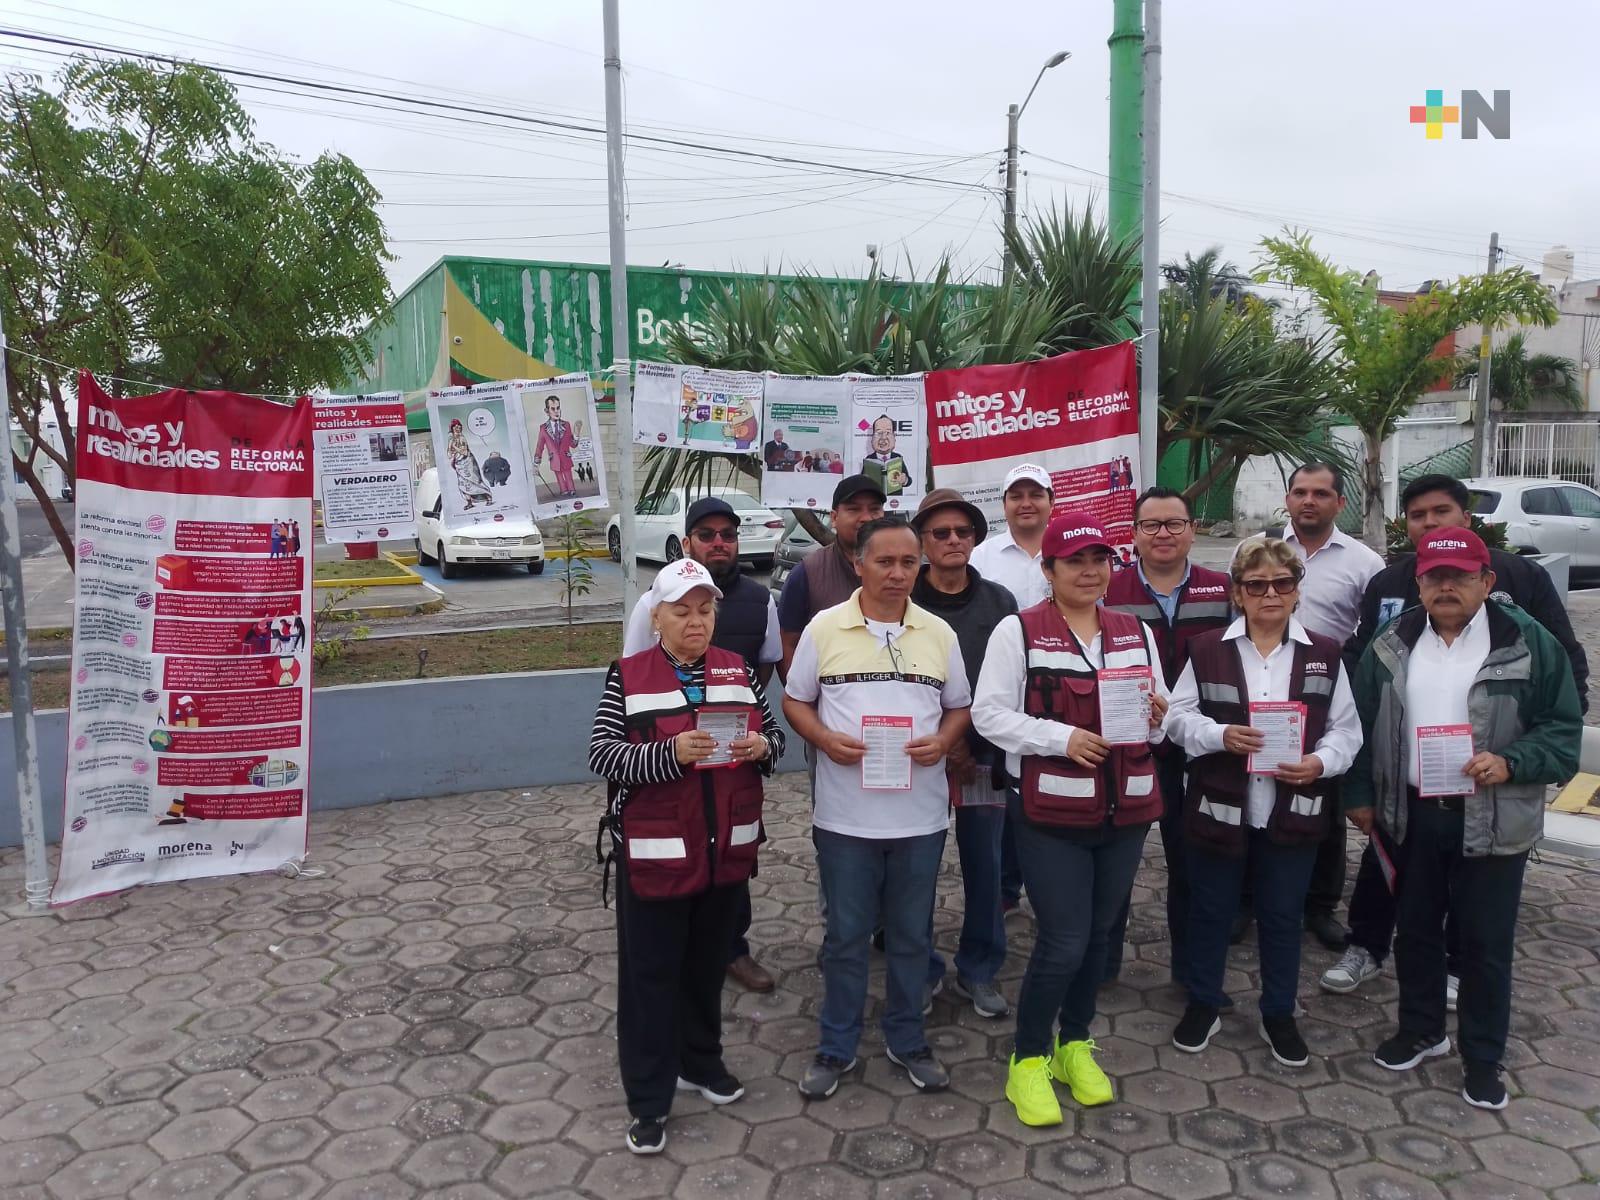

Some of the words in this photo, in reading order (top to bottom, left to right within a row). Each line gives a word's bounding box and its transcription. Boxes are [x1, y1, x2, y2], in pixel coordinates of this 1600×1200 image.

[440, 387, 469, 398] Formación
[476, 384, 509, 394] Movimiento
[1067, 389, 1085, 400] DE
[326, 396, 357, 404] Formación
[936, 391, 1004, 418] mitos
[1009, 388, 1026, 413] y
[1067, 390, 1130, 412] REFORMA
[315, 409, 346, 418] mitos
[351, 409, 358, 418] y
[1068, 401, 1131, 423] ELECTORAL
[87, 404, 161, 443] mos
[164, 420, 184, 447] y
[316, 418, 372, 428] realidades
[938, 407, 1061, 443] realidades
[231, 437, 251, 447] DE
[327, 433, 356, 443] FALSO
[87, 433, 220, 470] realidades
[230, 448, 305, 461] REFORMA
[230, 460, 305, 472] ELECTORAL
[333, 474, 397, 486] VERDADERO
[976, 487, 1001, 495] electoral
[90, 514, 116, 524] reforma
[101, 527, 123, 536] contra
[133, 531, 163, 541] minorías.
[1062, 527, 1104, 540] morena
[1428, 539, 1469, 550] morena
[1188, 585, 1225, 594] morena
[1112, 634, 1141, 643] morena
[710, 667, 744, 675] morena
[1305, 662, 1328, 670] rena
[104, 848, 130, 858] UNIDAD
[158, 840, 213, 856] morena
